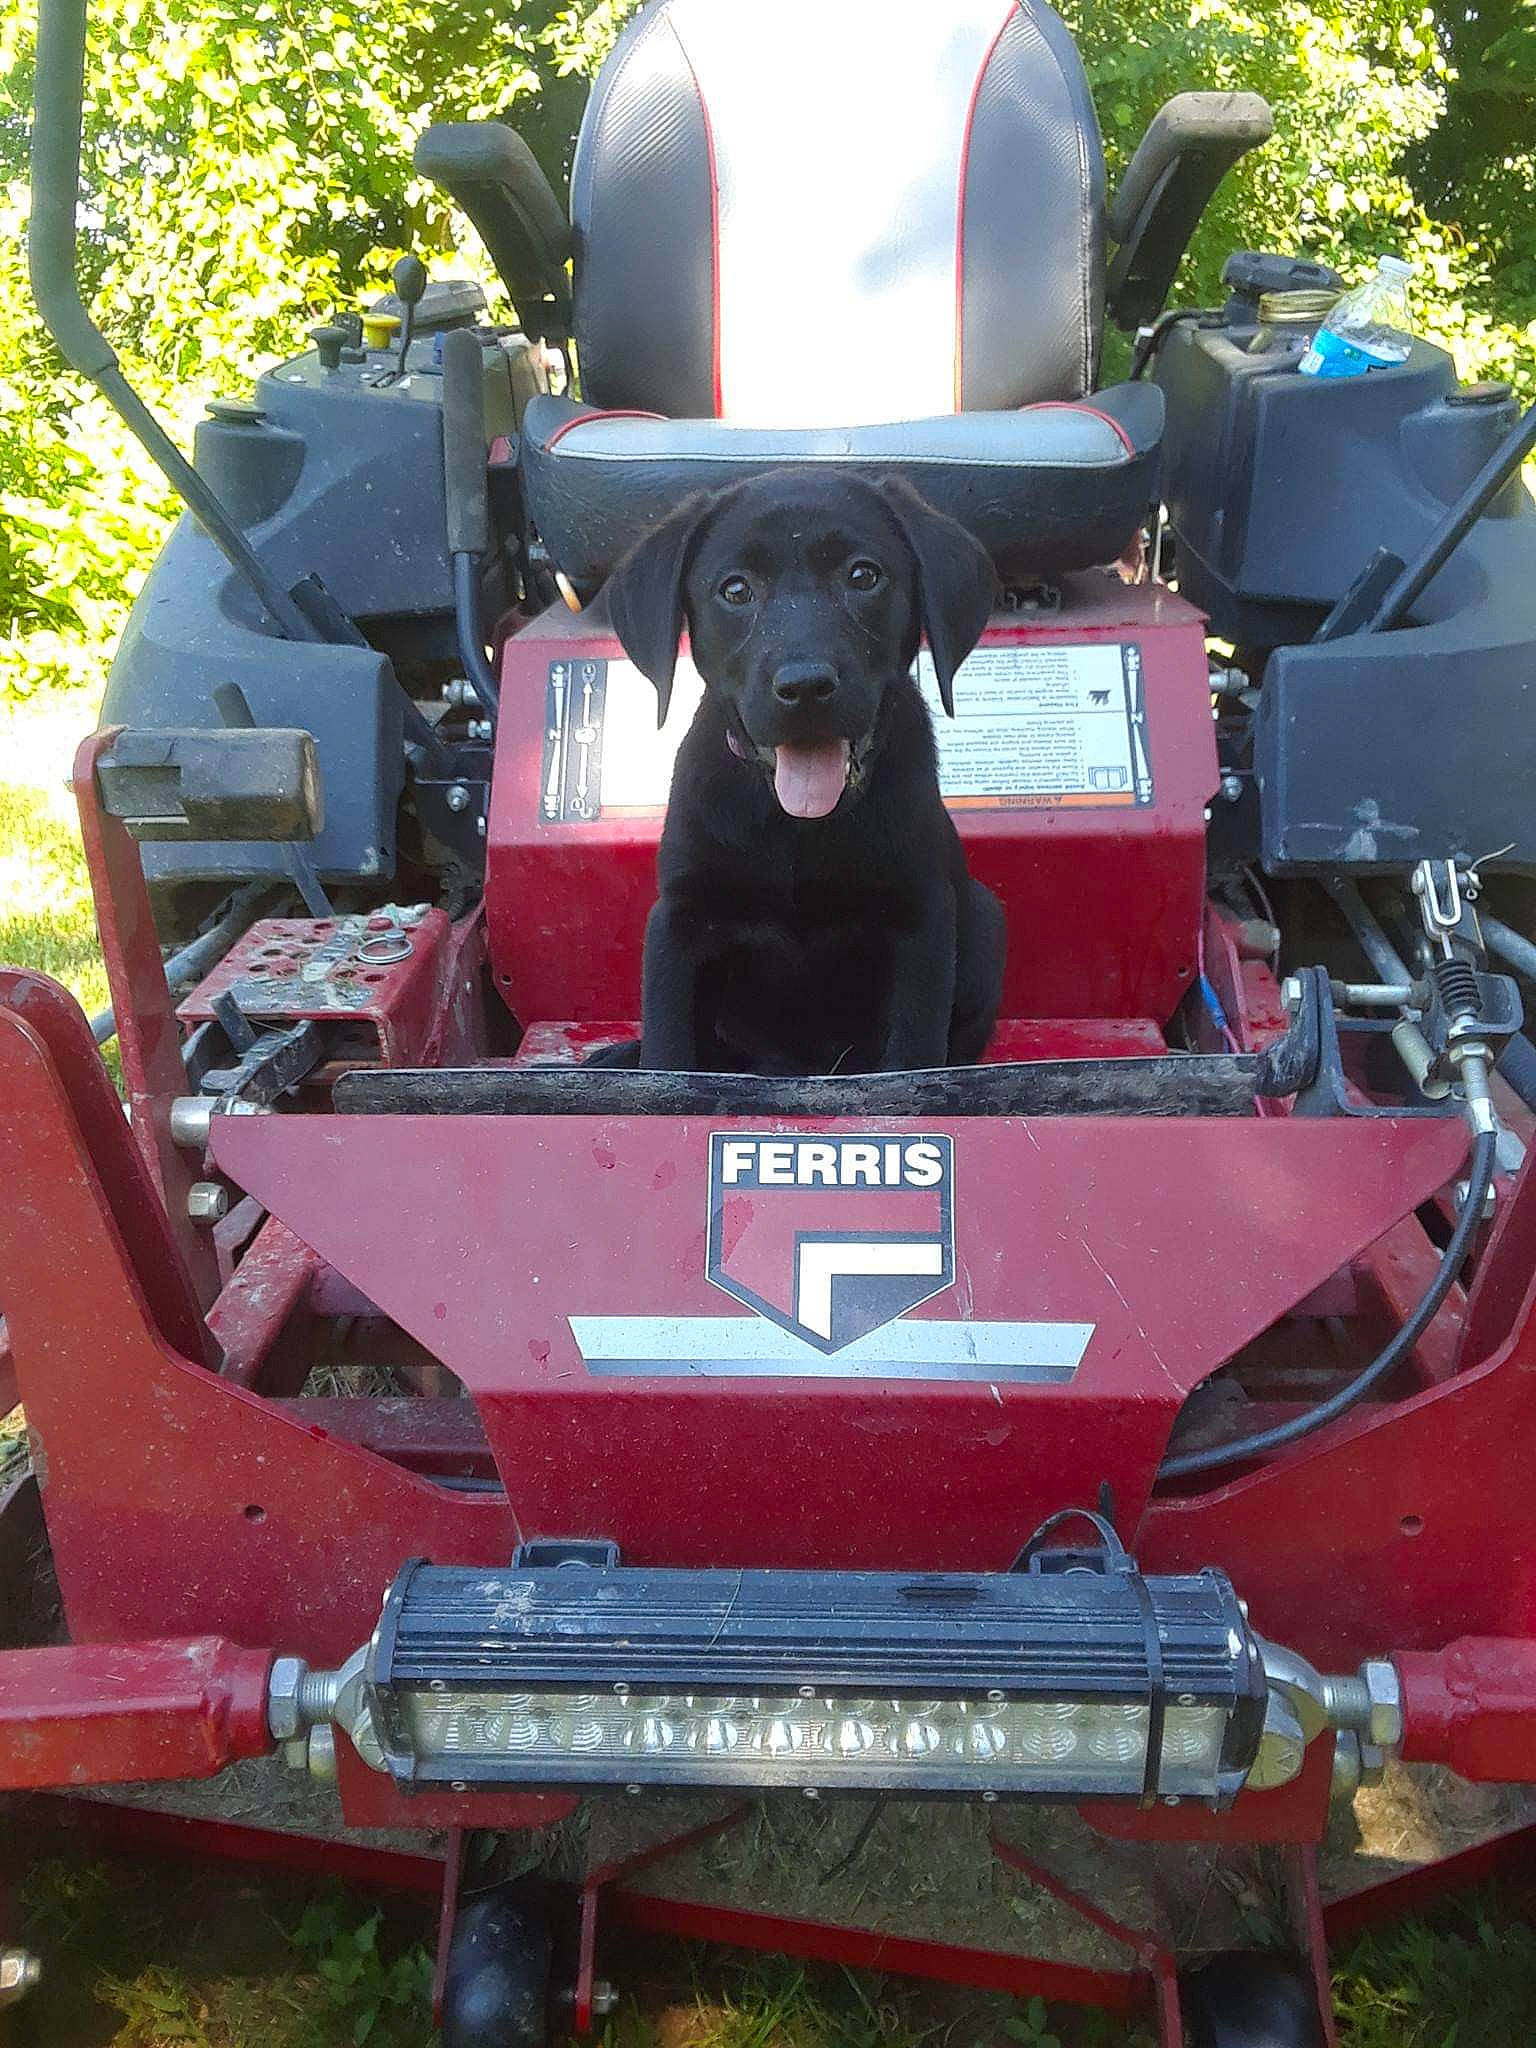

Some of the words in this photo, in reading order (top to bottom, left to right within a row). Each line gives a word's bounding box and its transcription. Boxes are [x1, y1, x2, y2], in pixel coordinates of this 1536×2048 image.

[549, 728, 562, 742] N
[999, 797, 1052, 808] WARNING
[722, 1142, 943, 1187] FERRIS
